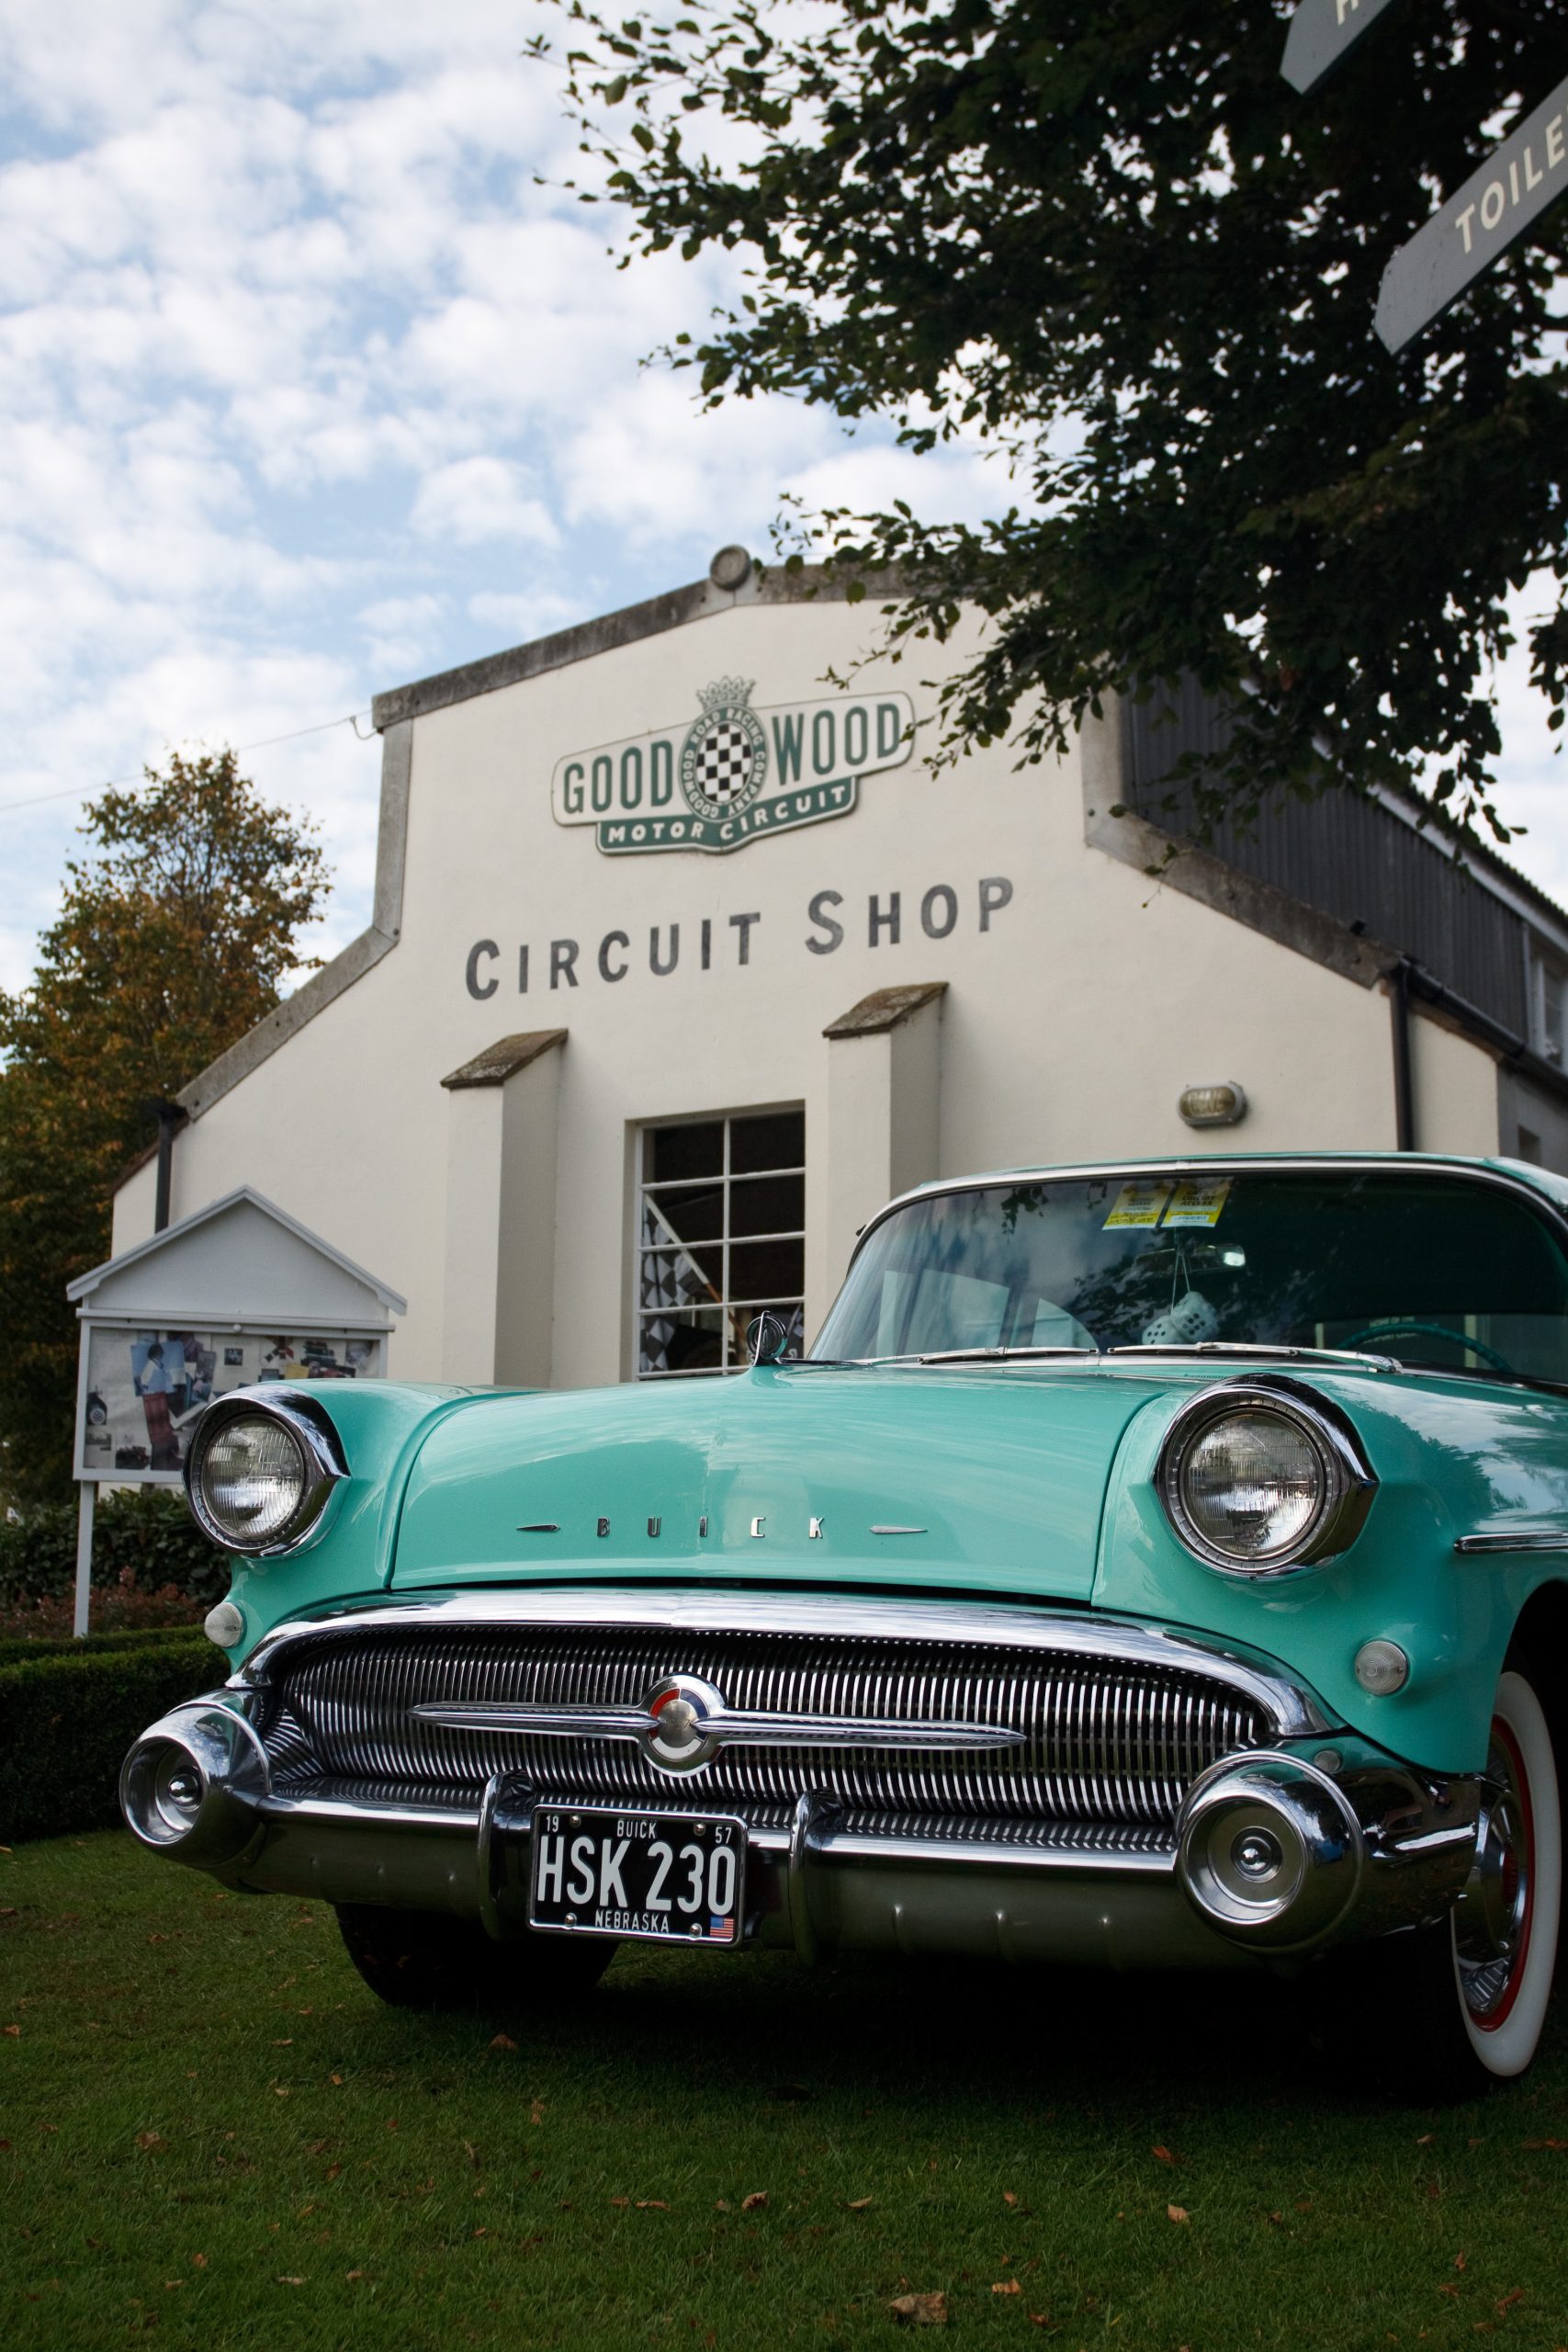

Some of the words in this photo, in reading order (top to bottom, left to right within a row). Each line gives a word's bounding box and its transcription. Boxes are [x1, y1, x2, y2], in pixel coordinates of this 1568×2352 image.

[1455, 105, 1568, 254] TOILE
[690, 711, 720, 744] ROAD
[726, 707, 763, 746] RACING
[563, 740, 673, 814] GOOD
[772, 703, 901, 786] WOOD
[682, 750, 719, 818] GOODWOOD
[728, 751, 765, 817] COMPANY
[607, 821, 704, 842] MOTOR
[720, 786, 847, 841] CIRCUIT
[465, 911, 761, 1001] CIRCUIT
[805, 876, 1015, 956] SHOP
[596, 1516, 825, 1539] BUICK
[546, 1815, 559, 1833] 19
[616, 1819, 658, 1839] BUICK
[715, 1826, 732, 1845] 57
[536, 1835, 633, 1908] HSK
[645, 1840, 736, 1917] 230
[595, 1910, 670, 1933] NEBRASKA
